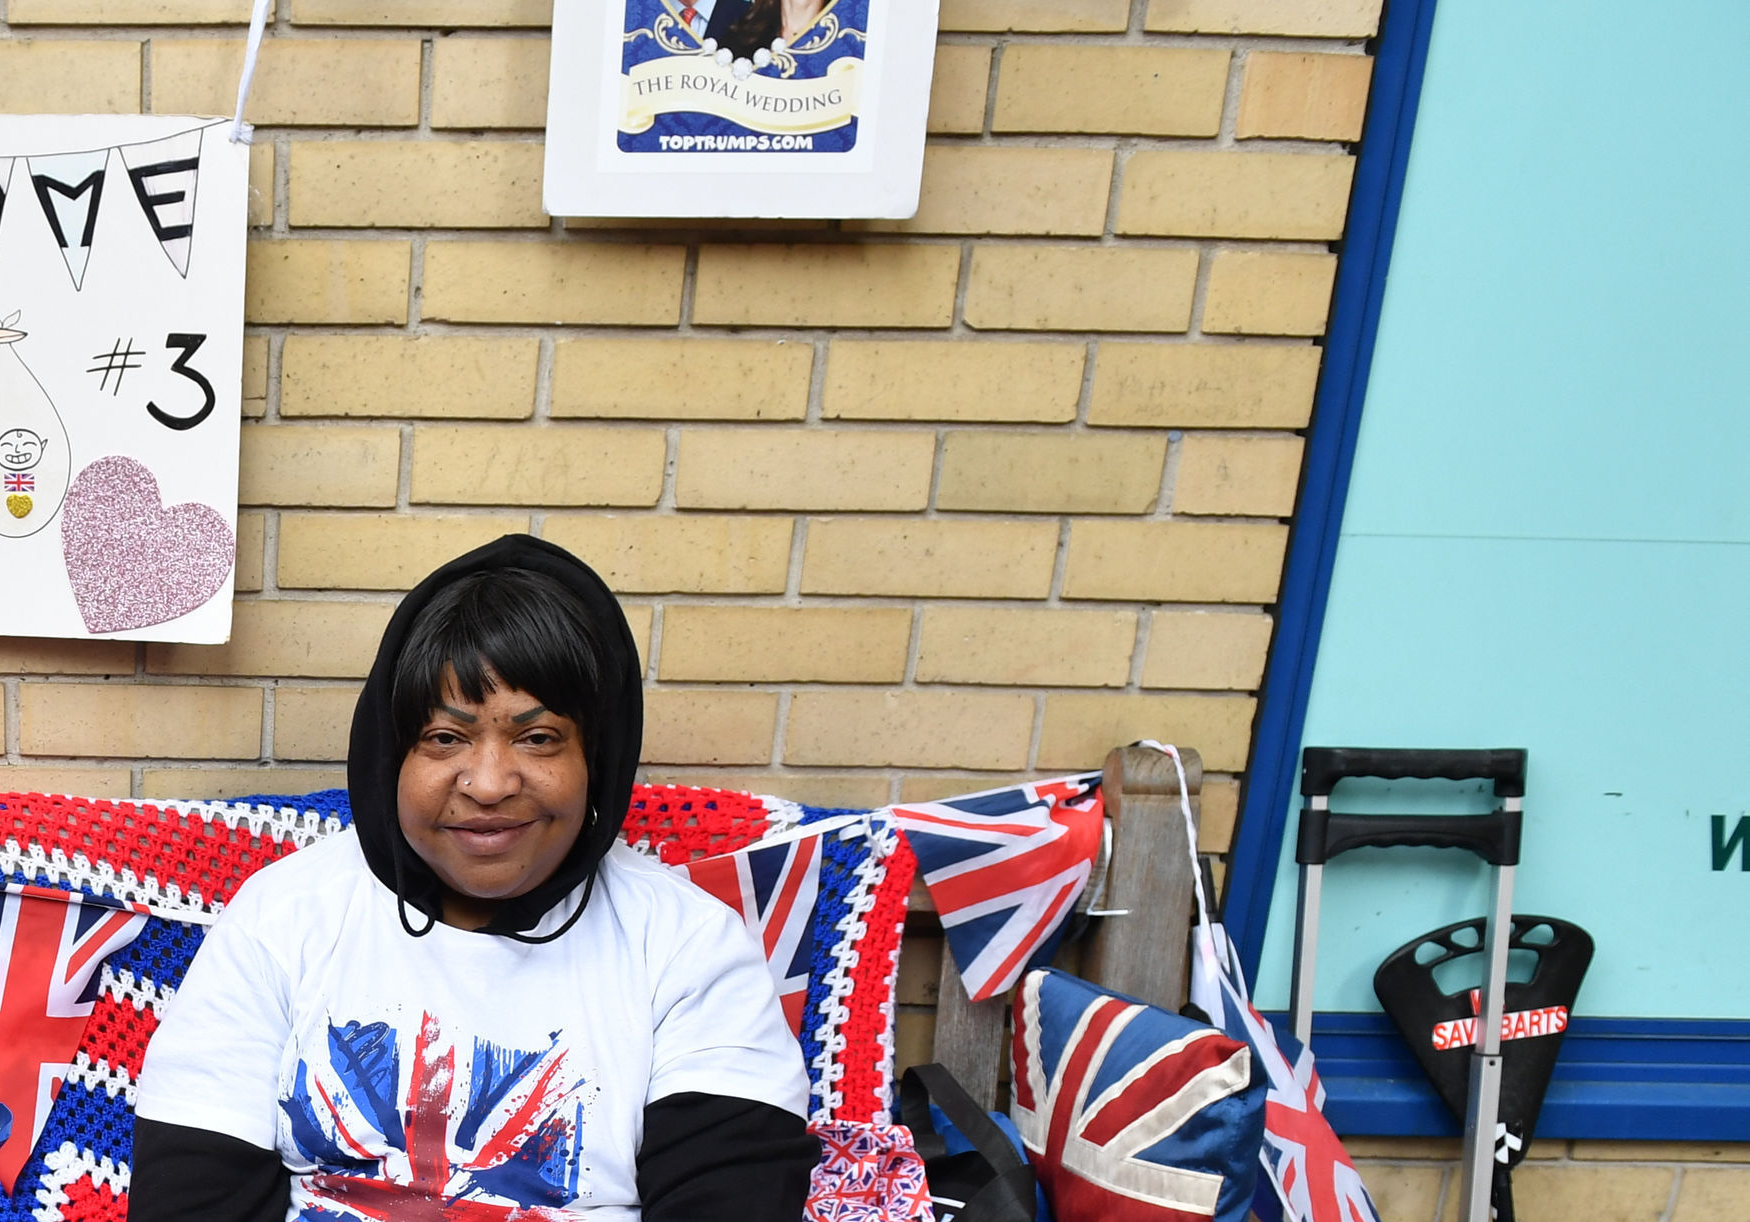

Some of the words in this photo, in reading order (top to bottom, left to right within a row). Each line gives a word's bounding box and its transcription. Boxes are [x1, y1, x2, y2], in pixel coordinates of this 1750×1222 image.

[633, 75, 673, 95] THE
[680, 75, 739, 100] ROYAL
[745, 89, 842, 113] WEDDING
[659, 135, 813, 151] TOPTRUMPS.COM
[86, 333, 215, 430] #3
[1432, 1018, 1478, 1051] SAV
[1501, 1004, 1569, 1041] BARTS
